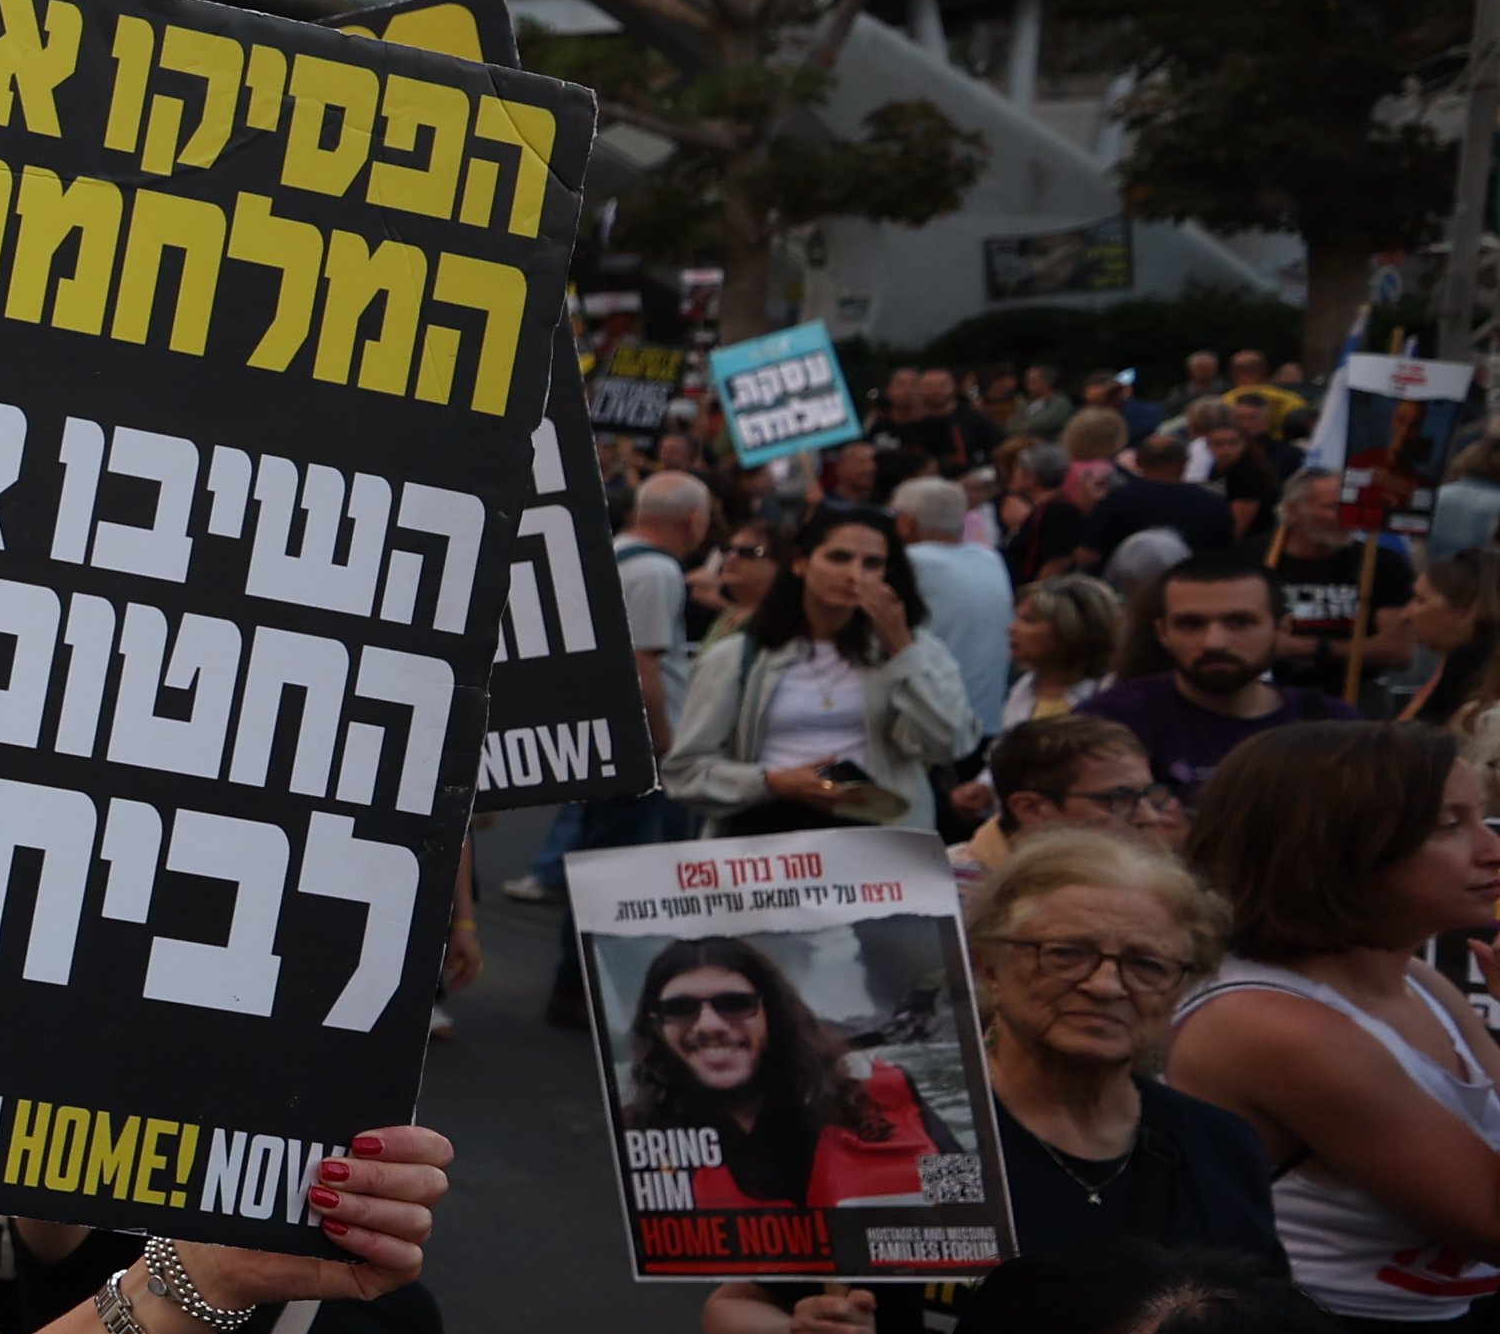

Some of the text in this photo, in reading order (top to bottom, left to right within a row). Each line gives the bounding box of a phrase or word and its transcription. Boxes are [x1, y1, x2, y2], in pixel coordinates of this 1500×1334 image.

[102, 12, 559, 240] הפסיקו
[51, 416, 488, 635] השיבו
[479, 718, 617, 793] NOW!
[677, 852, 823, 891] סהר ברוך (25)
[661, 895, 702, 919] חטוף
[704, 890, 746, 916] עדיין
[804, 886, 829, 907] ידי
[833, 883, 858, 905] על
[861, 880, 904, 904] נרצח
[4, 1105, 197, 1209] HOME!
[625, 1127, 722, 1169] BRING
[632, 1170, 695, 1212] HIM
[640, 1211, 832, 1258] HOME NOW!
[869, 1240, 999, 1262] FAMILIES FORUM
